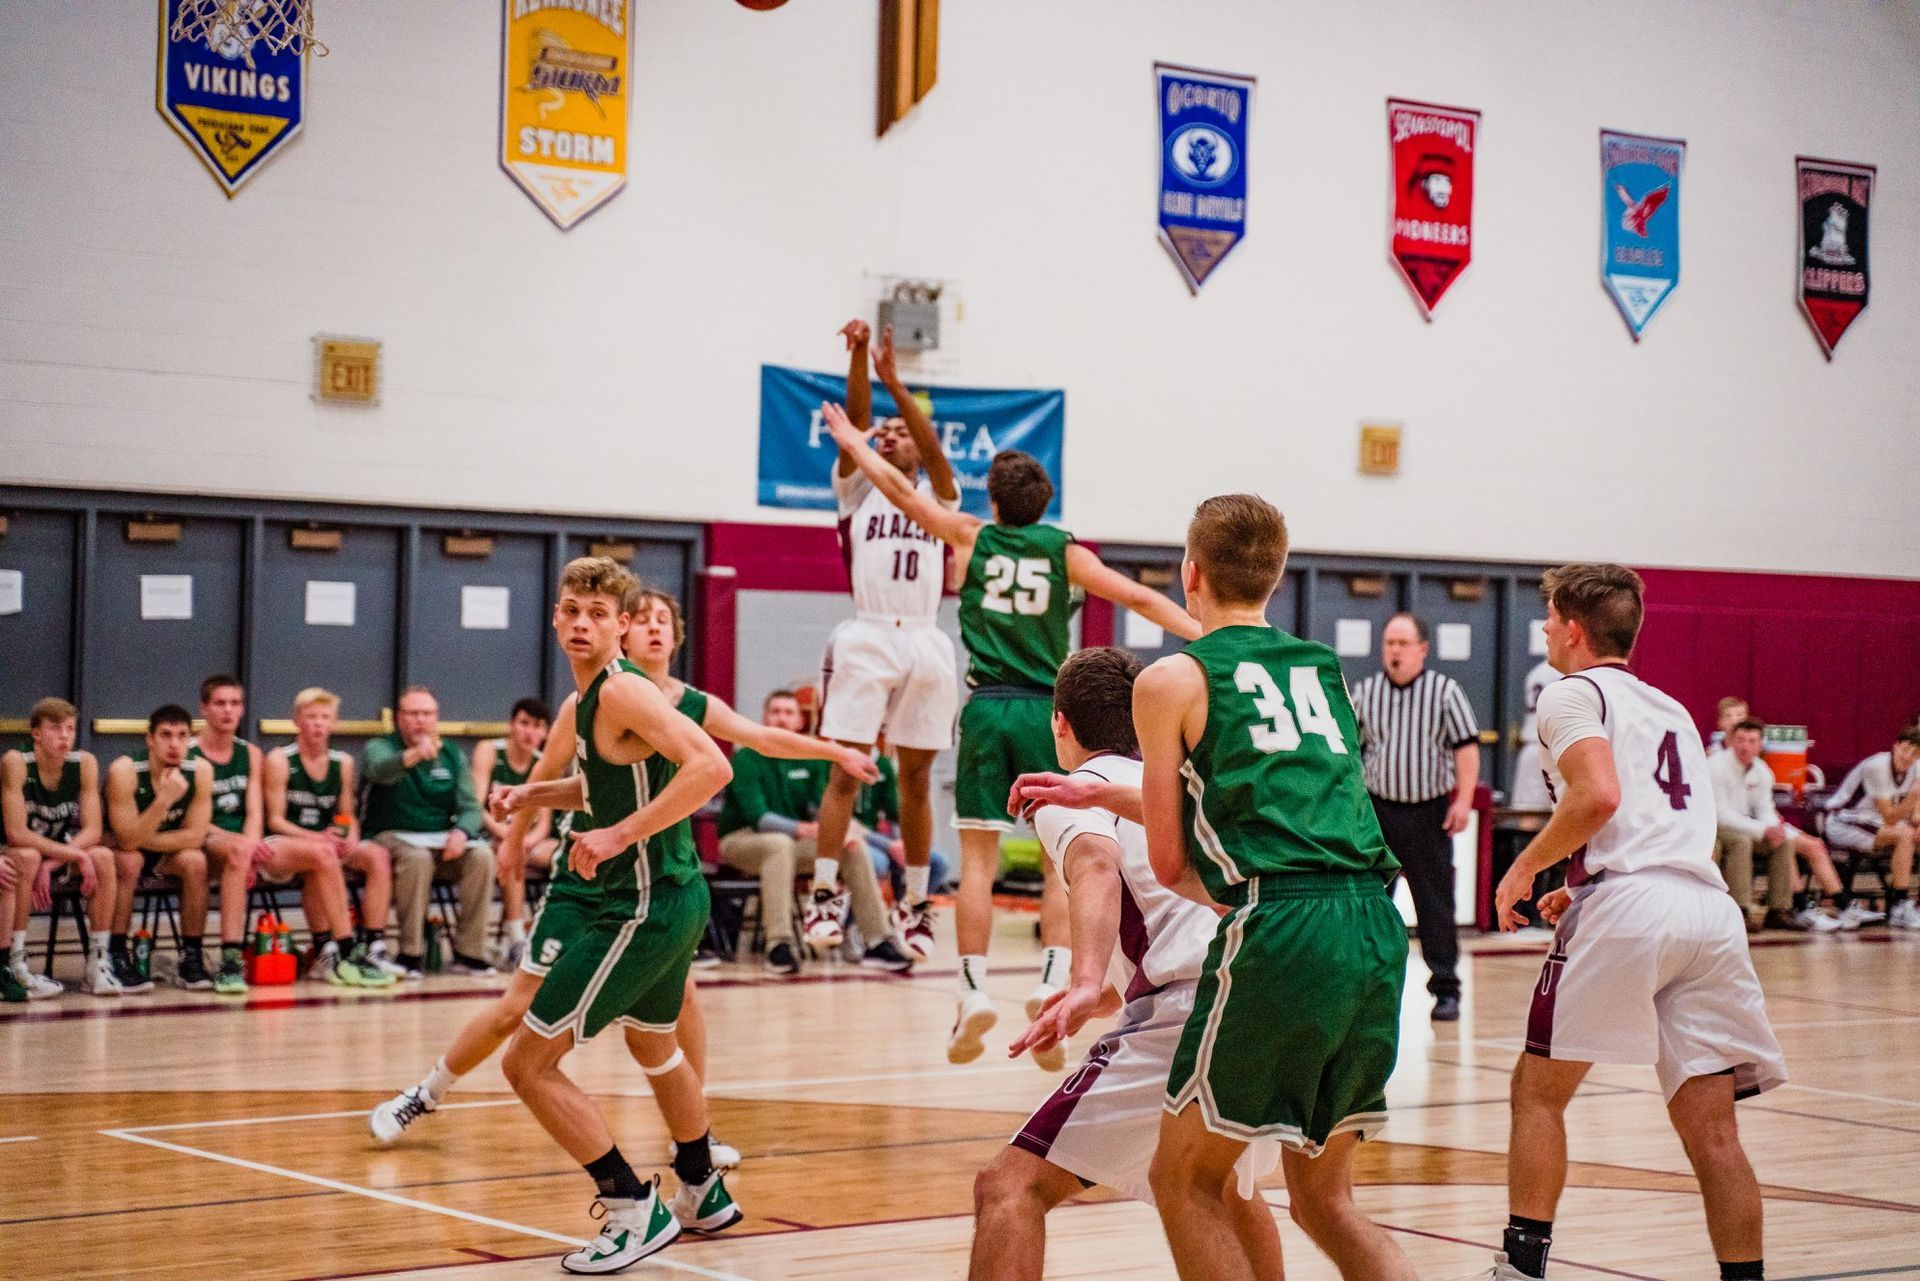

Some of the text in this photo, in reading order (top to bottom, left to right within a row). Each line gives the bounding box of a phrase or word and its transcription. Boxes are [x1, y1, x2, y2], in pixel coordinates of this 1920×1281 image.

[184, 62, 291, 103] VIKINGS
[1166, 81, 1242, 124] OCONTO
[519, 126, 616, 165] STORM
[1396, 218, 1470, 246] PIONEERS
[1803, 266, 1865, 296] CLIPPERS
[892, 549, 919, 582] 10
[981, 554, 1052, 617] 25
[1233, 661, 1349, 755] 34
[1653, 730, 1692, 811] 4
[539, 938, 563, 963] S
